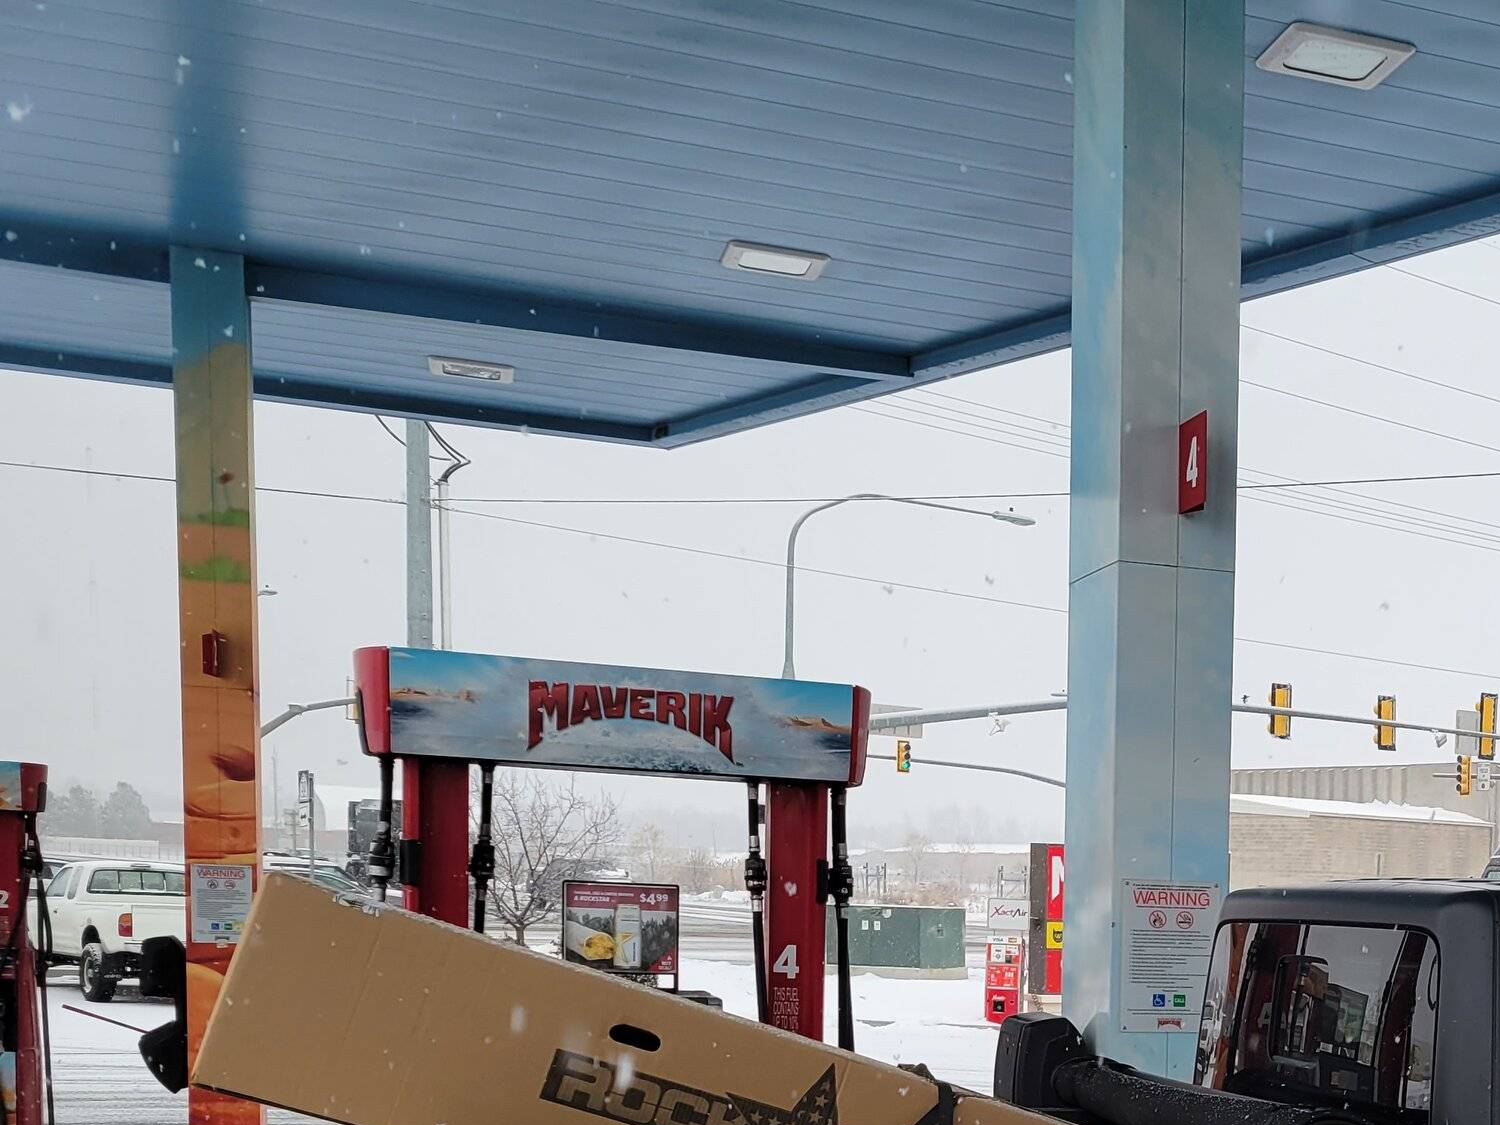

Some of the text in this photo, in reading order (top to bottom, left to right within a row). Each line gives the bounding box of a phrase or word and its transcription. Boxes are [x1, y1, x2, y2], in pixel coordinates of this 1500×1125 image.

[1186, 436, 1198, 488] 4
[526, 679, 734, 765] MAVERIK
[197, 868, 246, 880] WARNING
[1133, 889, 1211, 907] WARNING
[773, 944, 800, 979] 4
[773, 987, 799, 1001] THIS FUEL
[773, 1001, 799, 1015] CONTAINS
